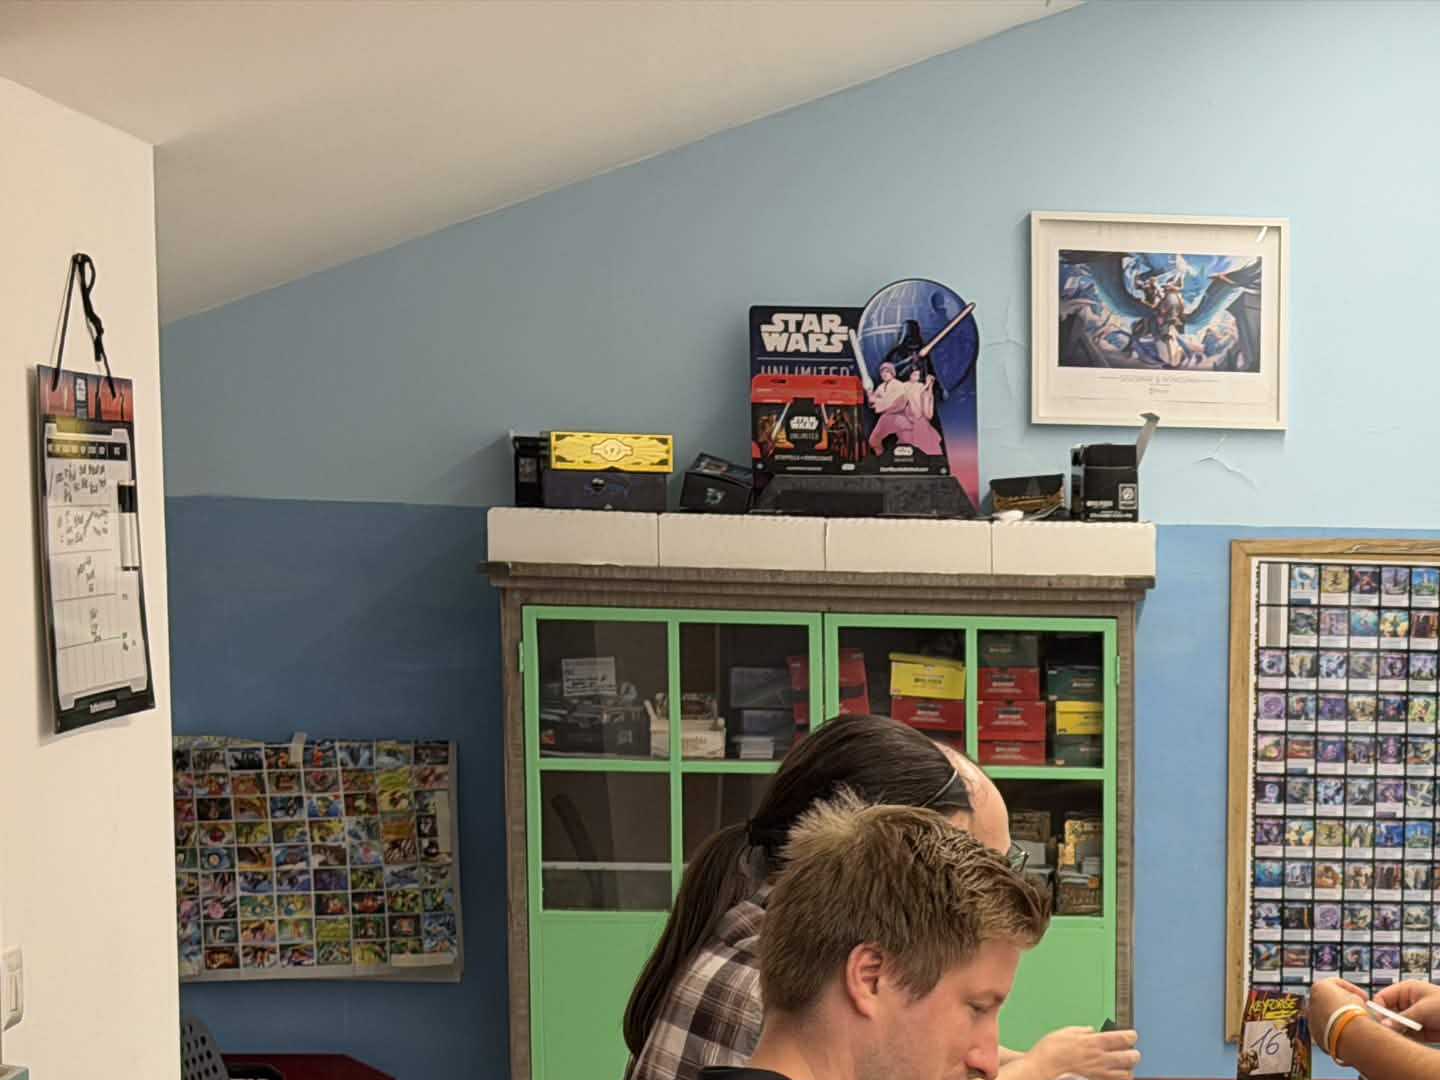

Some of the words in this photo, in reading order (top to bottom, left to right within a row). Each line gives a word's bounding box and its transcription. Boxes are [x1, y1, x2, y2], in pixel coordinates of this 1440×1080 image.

[760, 313, 848, 333] STAR
[761, 332, 849, 353] WARS
[1250, 1028, 1284, 1055] 16
